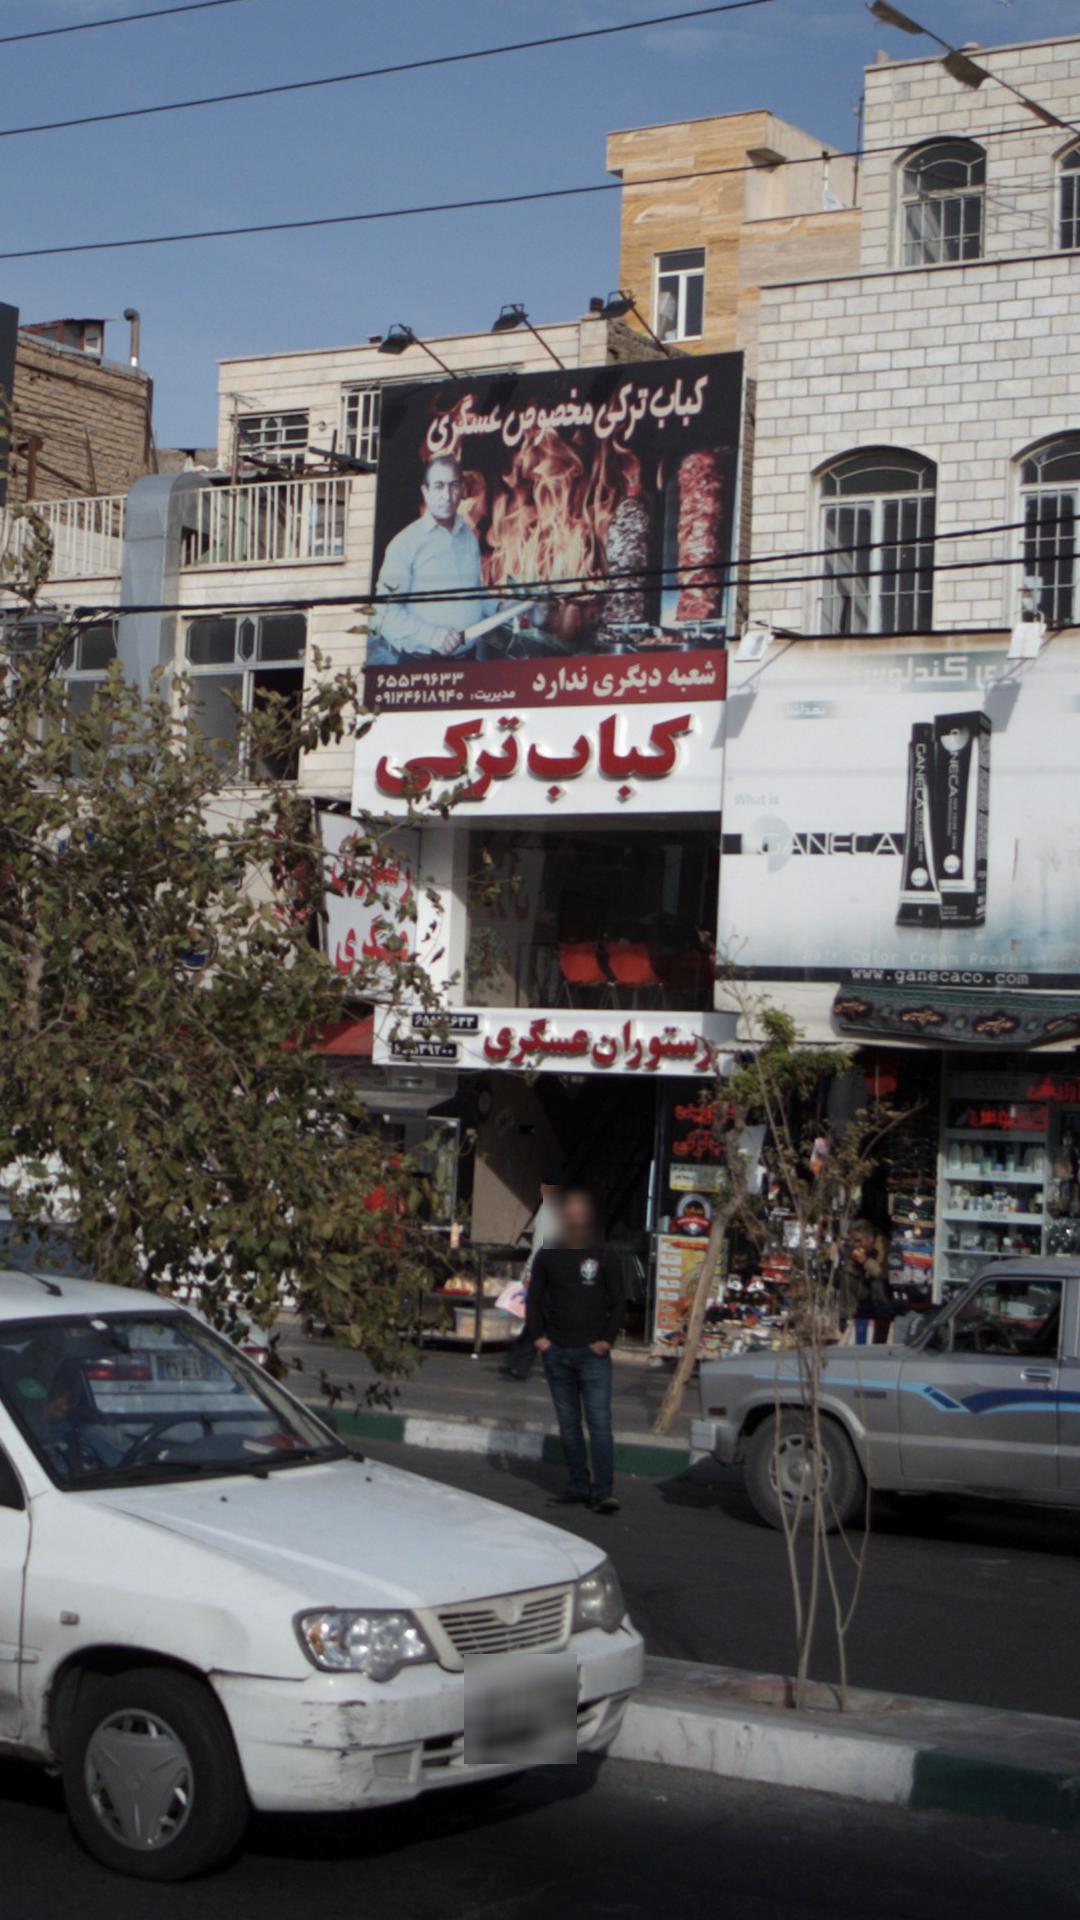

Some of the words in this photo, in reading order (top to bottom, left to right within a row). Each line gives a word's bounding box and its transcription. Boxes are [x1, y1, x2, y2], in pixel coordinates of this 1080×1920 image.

[502, 388, 594, 447] مخصوص
[594, 382, 649, 441] ترکی
[649, 375, 708, 429] کباب
[532, 666, 588, 700] ندارد
[593, 663, 662, 697] دیگری
[667, 661, 717, 692] شعبه
[375, 716, 521, 801] ترکی
[527, 713, 695, 800] کباب
[851, 968, 1030, 985] www.ganecaco.com
[484, 1018, 589, 1065] عسگری
[592, 1019, 712, 1070] رستوران
